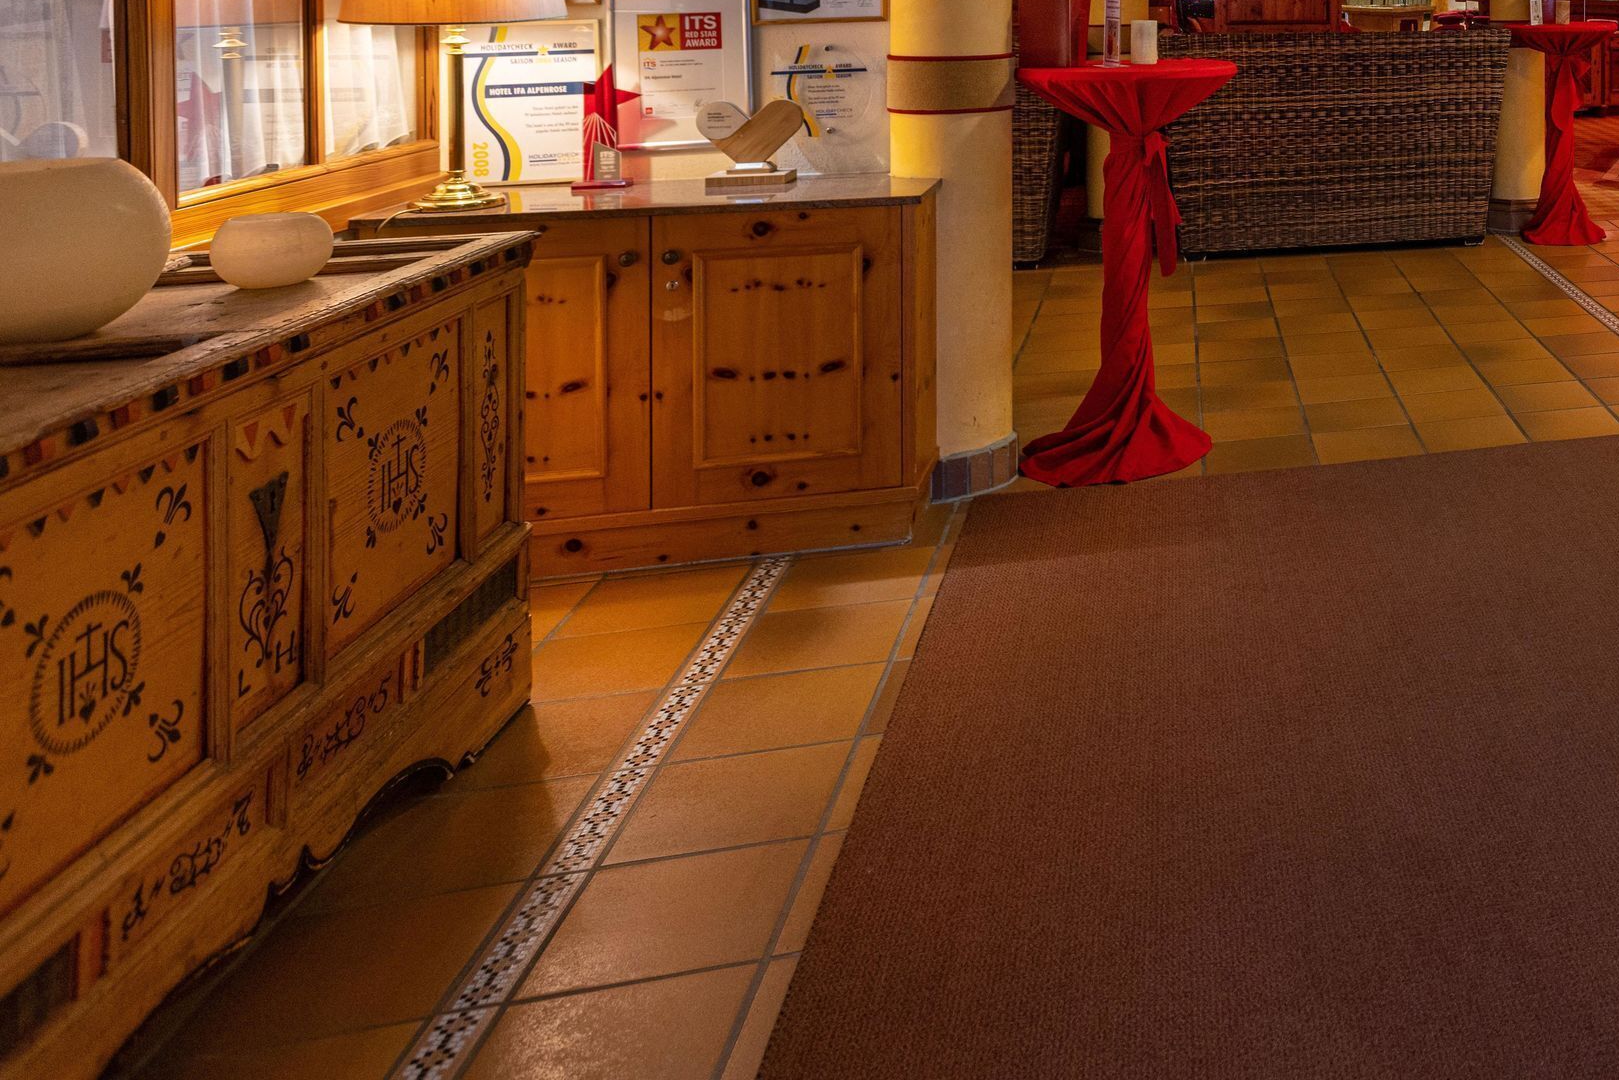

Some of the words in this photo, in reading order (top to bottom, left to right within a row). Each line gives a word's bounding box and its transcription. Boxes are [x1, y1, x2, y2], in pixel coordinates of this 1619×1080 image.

[684, 15, 717, 30] ITS
[700, 30, 717, 38] STAR
[480, 43, 533, 52] HOLIDAYCHECK
[552, 41, 578, 49] AWARD
[685, 38, 718, 48] AWARD
[510, 57, 534, 65] SAISON
[489, 88, 512, 96] HOTEL
[513, 87, 526, 95] IFA
[527, 85, 568, 95] ALPENROSE
[472, 142, 490, 177] 2008
[380, 435, 421, 514] IHS
[57, 620, 130, 727] IHS
